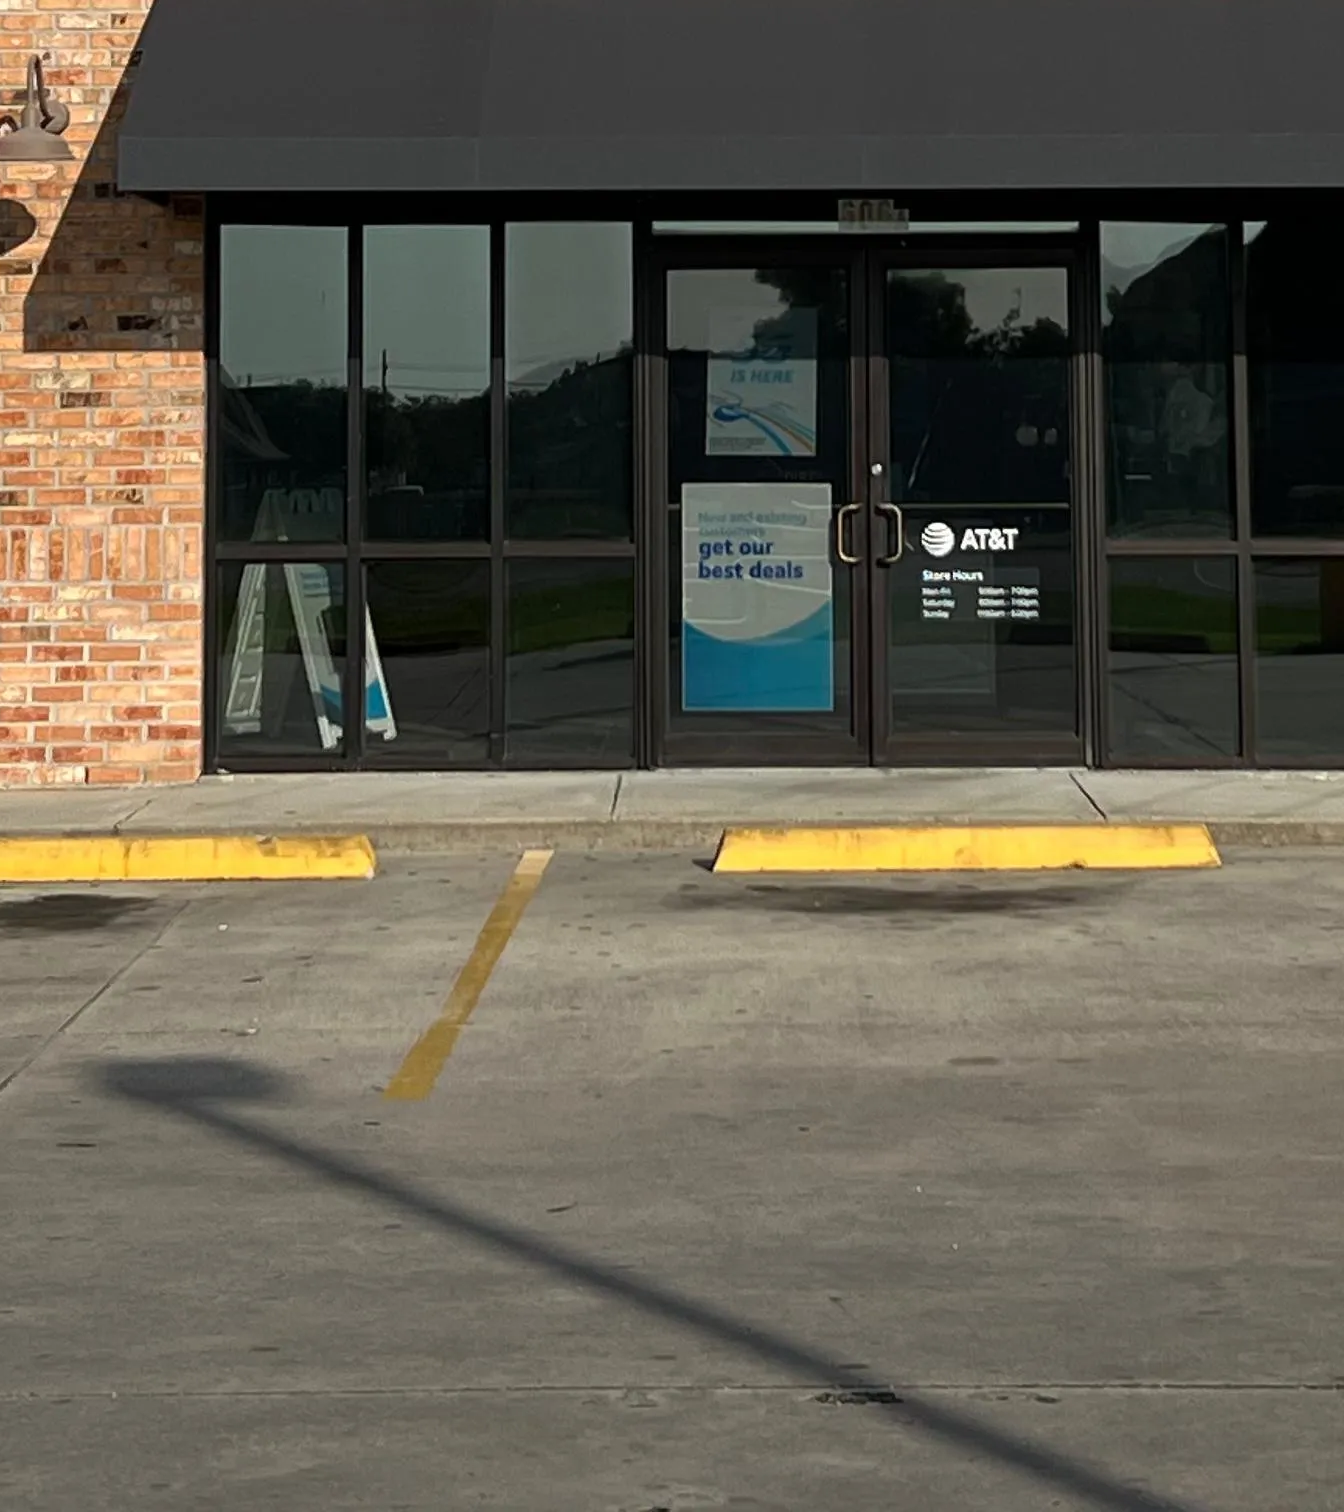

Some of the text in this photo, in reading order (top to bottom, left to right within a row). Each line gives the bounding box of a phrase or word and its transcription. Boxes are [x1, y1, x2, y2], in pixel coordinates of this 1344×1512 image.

[730, 369, 795, 384] IS HERE
[960, 527, 1019, 551] AT&T
[699, 539, 774, 560] get our
[698, 559, 804, 579] best deals
[922, 569, 984, 582] Store Hours
